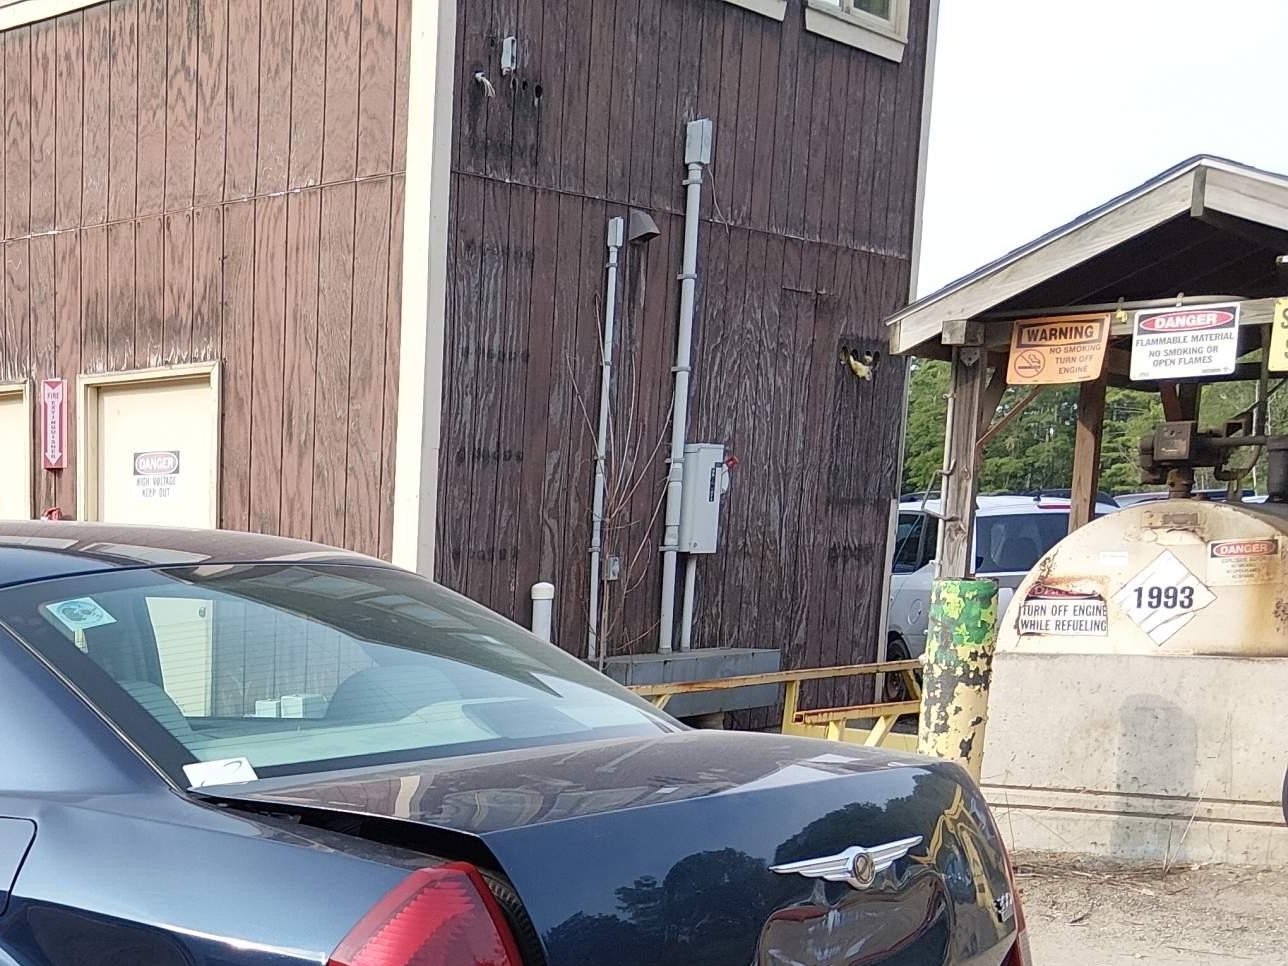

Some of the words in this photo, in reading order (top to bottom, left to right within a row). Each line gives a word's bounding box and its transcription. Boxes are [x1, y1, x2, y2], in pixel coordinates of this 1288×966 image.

[1154, 313, 1218, 329] DANGER
[1027, 325, 1094, 342] WARNING
[1135, 335, 1188, 347] FLAMMABLE
[1190, 332, 1234, 342] MATERIAL
[1064, 344, 1101, 354] SMOKING
[1149, 350, 1161, 358] NO
[1164, 347, 1203, 356] SMOKING
[1206, 345, 1219, 353] OR
[1055, 356, 1077, 364] TURN
[1152, 358, 1176, 367] OPEN
[1178, 356, 1213, 365] FLAMES
[1059, 366, 1088, 374] ENGINE
[139, 455, 174, 470] DANGER
[1220, 544, 1268, 554] DANGER
[1134, 586, 1195, 609] 1993
[1022, 604, 1047, 617] TURN
[1052, 604, 1069, 617] OFF
[1073, 604, 1107, 617] ENGINE
[1020, 619, 1050, 631] WHILE
[1055, 619, 1107, 632] REFUELING
